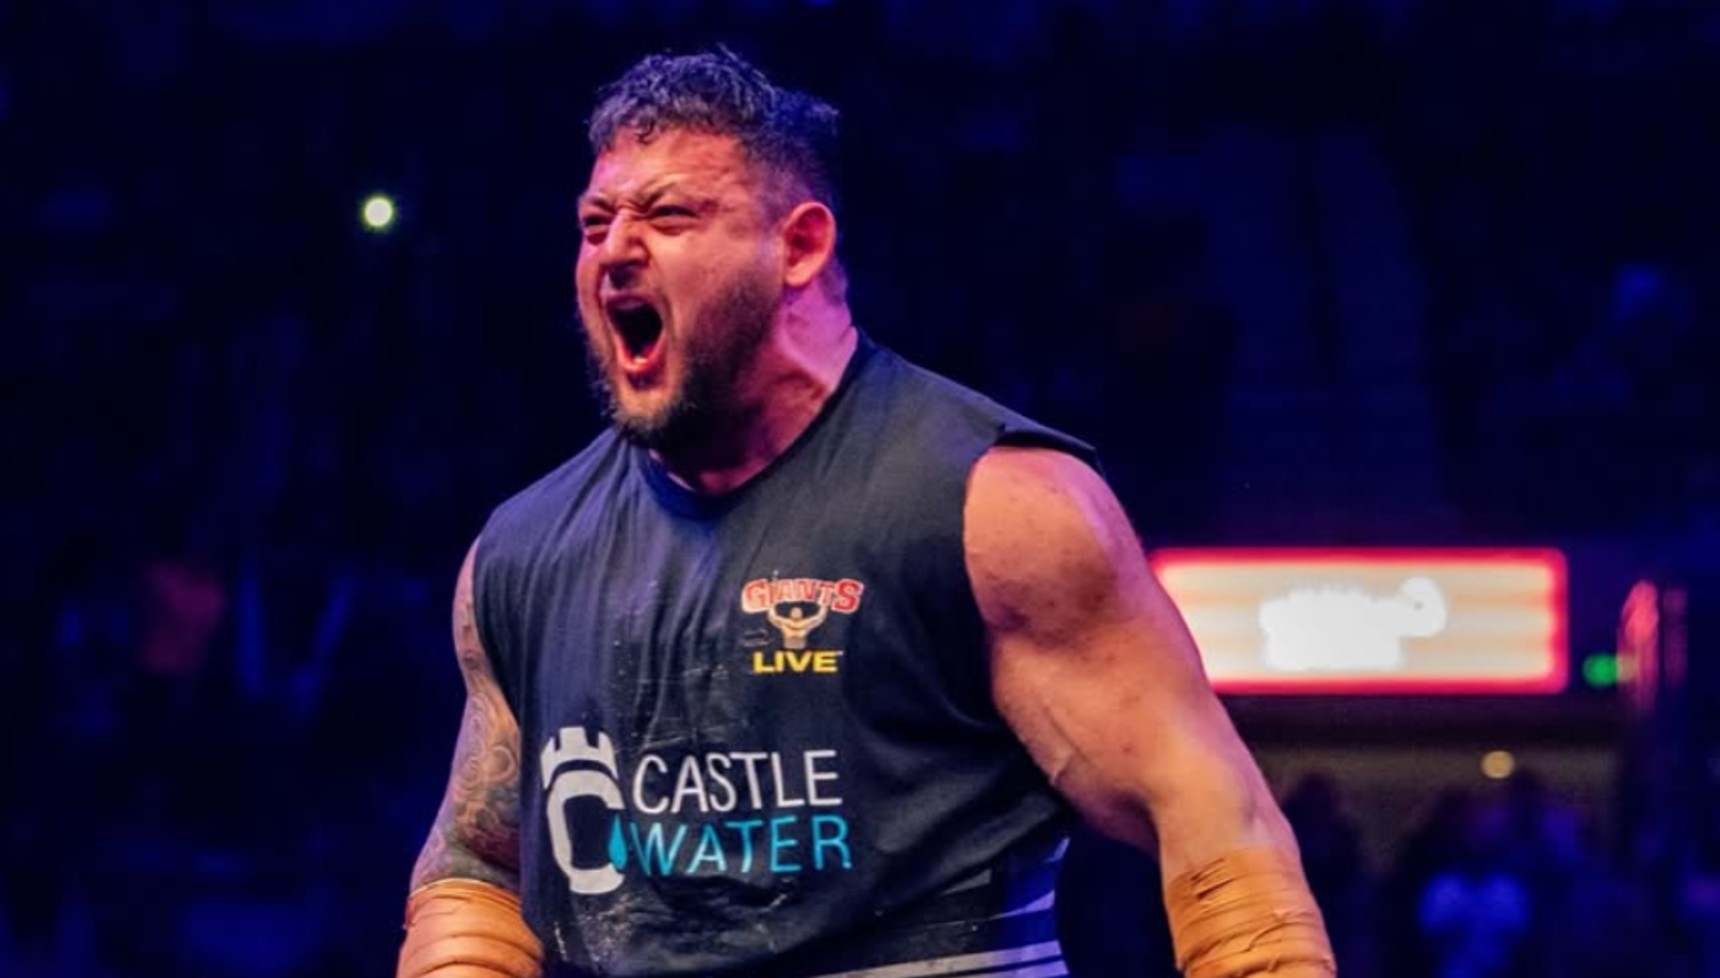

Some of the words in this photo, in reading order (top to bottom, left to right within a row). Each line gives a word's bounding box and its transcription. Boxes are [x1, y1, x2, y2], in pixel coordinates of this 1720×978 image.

[742, 578, 864, 613] GIANTS
[752, 650, 838, 673] LIVE
[633, 750, 842, 814] CASTLE
[630, 815, 852, 876] WATER
